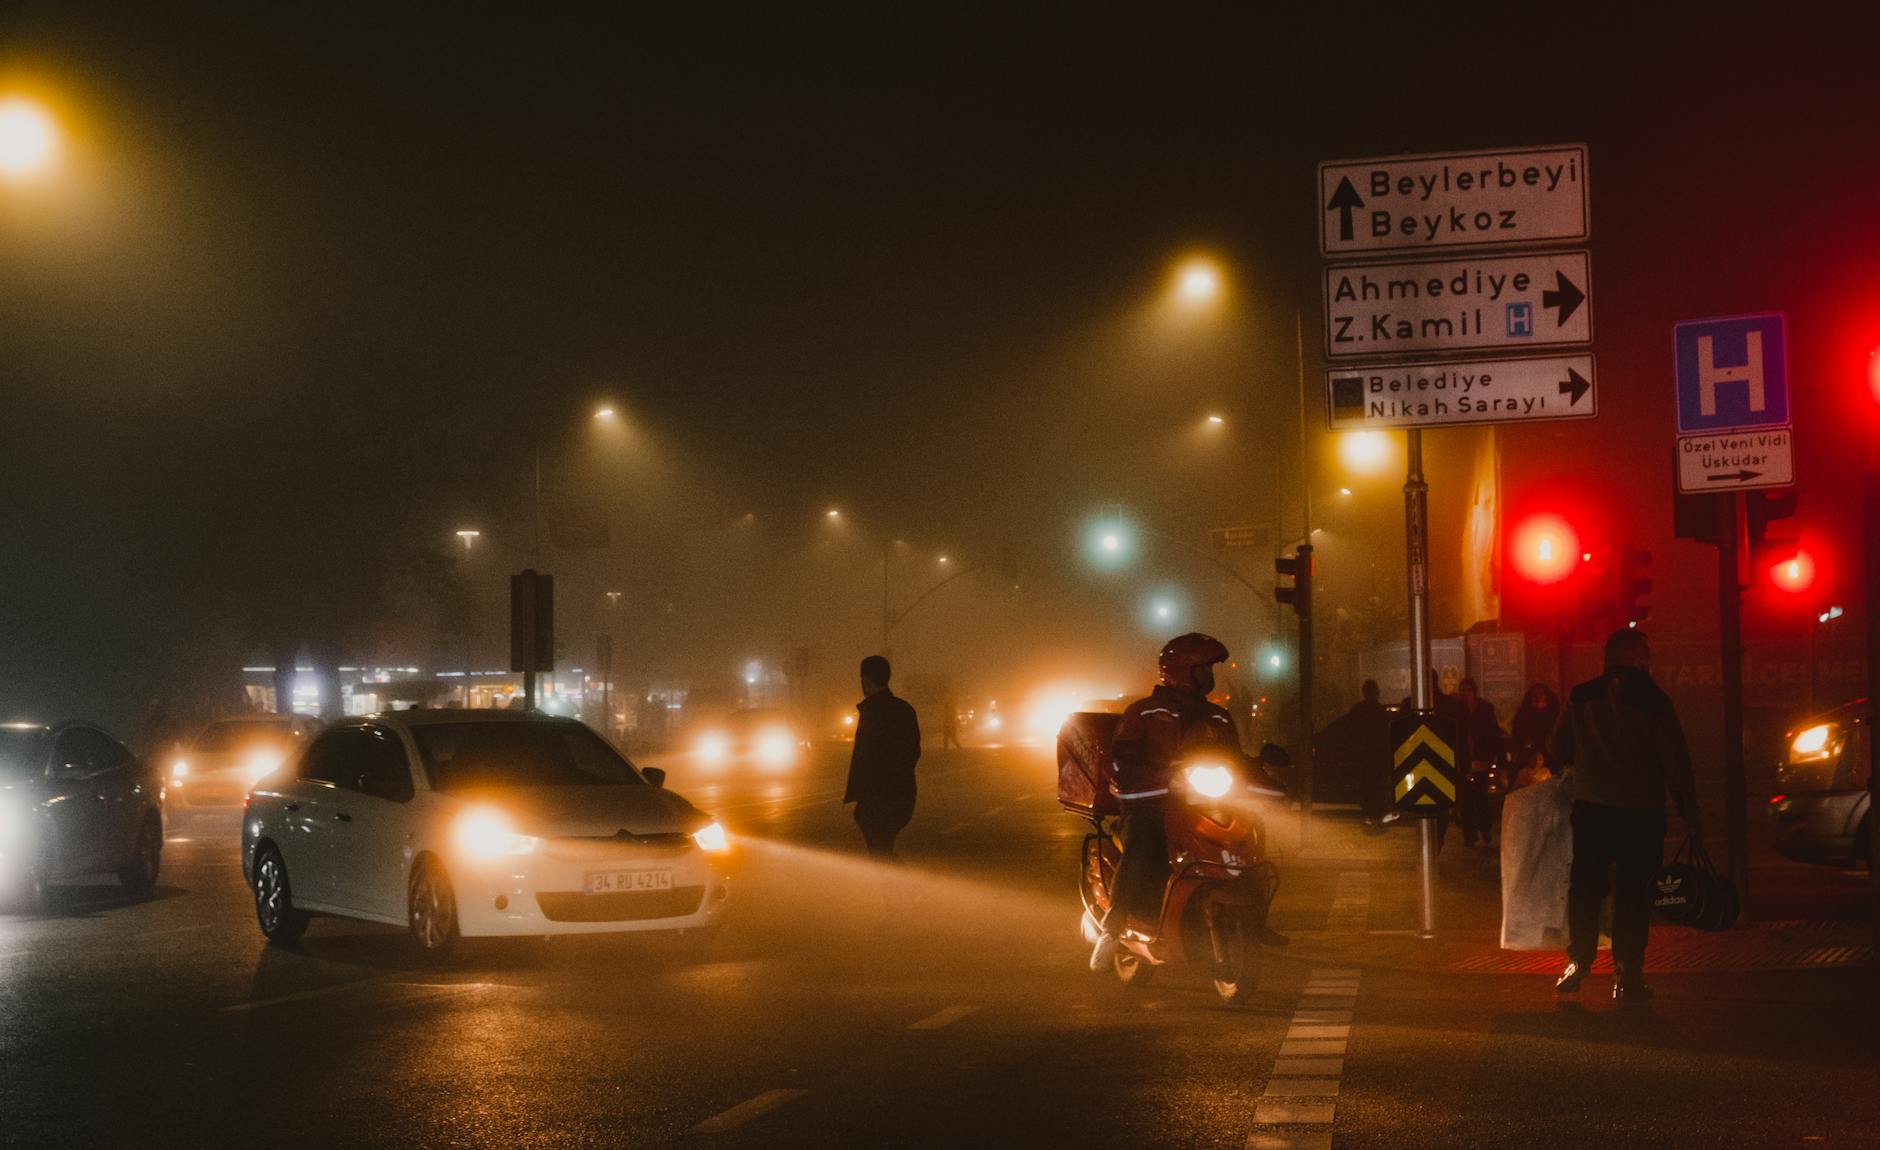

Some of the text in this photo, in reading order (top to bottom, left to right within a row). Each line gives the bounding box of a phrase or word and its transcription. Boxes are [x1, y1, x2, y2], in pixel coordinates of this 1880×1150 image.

[1369, 158, 1577, 202] Beylerbeyi
[1371, 205, 1518, 241] Beykoz
[1333, 269, 1532, 303] Ahmediye
[1334, 309, 1482, 343] Z.Kamil
[1369, 373, 1493, 394] Belediye
[1697, 330, 1766, 417] H
[1370, 395, 1545, 418] Nikah Sarayı
[1683, 434, 1787, 453] Özel Veni Vidi
[1702, 453, 1768, 469] Üsküdar
[595, 875, 610, 891] 34
[617, 873, 633, 889] RU
[1654, 896, 1687, 906] adidas
